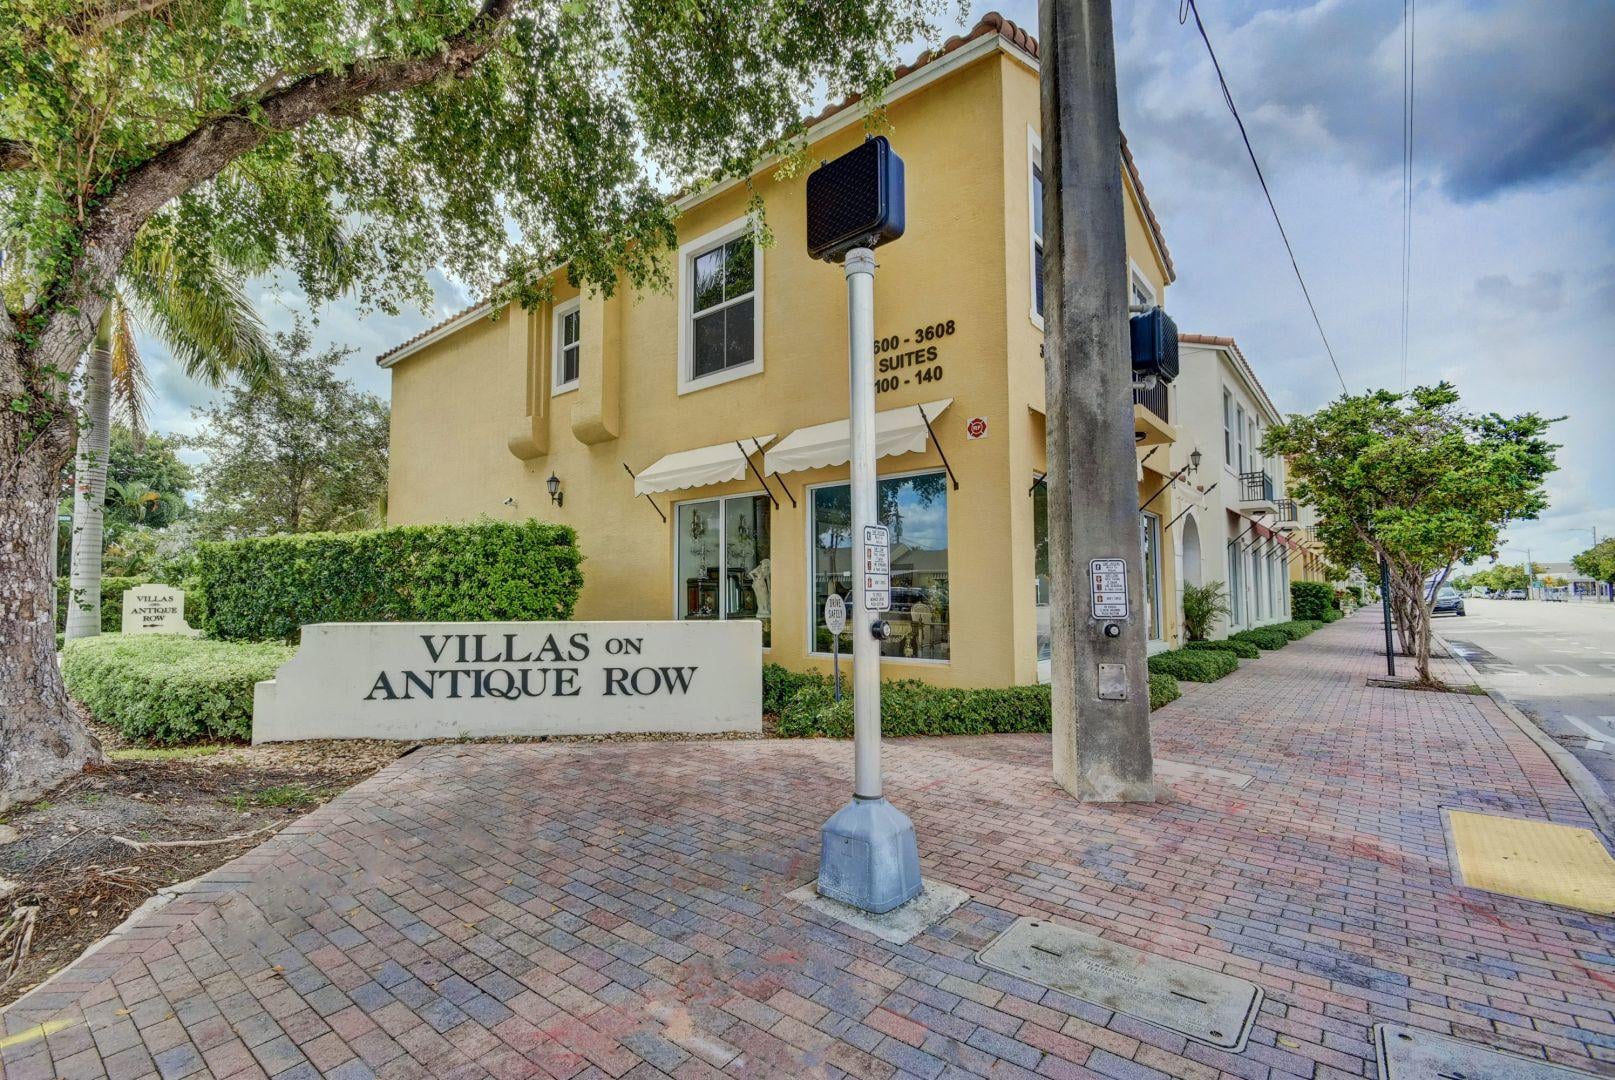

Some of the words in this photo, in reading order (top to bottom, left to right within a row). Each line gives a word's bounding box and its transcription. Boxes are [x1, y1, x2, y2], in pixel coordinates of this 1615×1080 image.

[915, 320, 955, 344] 3608
[879, 346, 937, 373] SUITES
[915, 366, 942, 384] 140
[420, 632, 590, 663] VILLAS
[605, 638, 643, 655] ON
[363, 668, 581, 701] ANTIQUE
[602, 666, 698, 696] ROW
